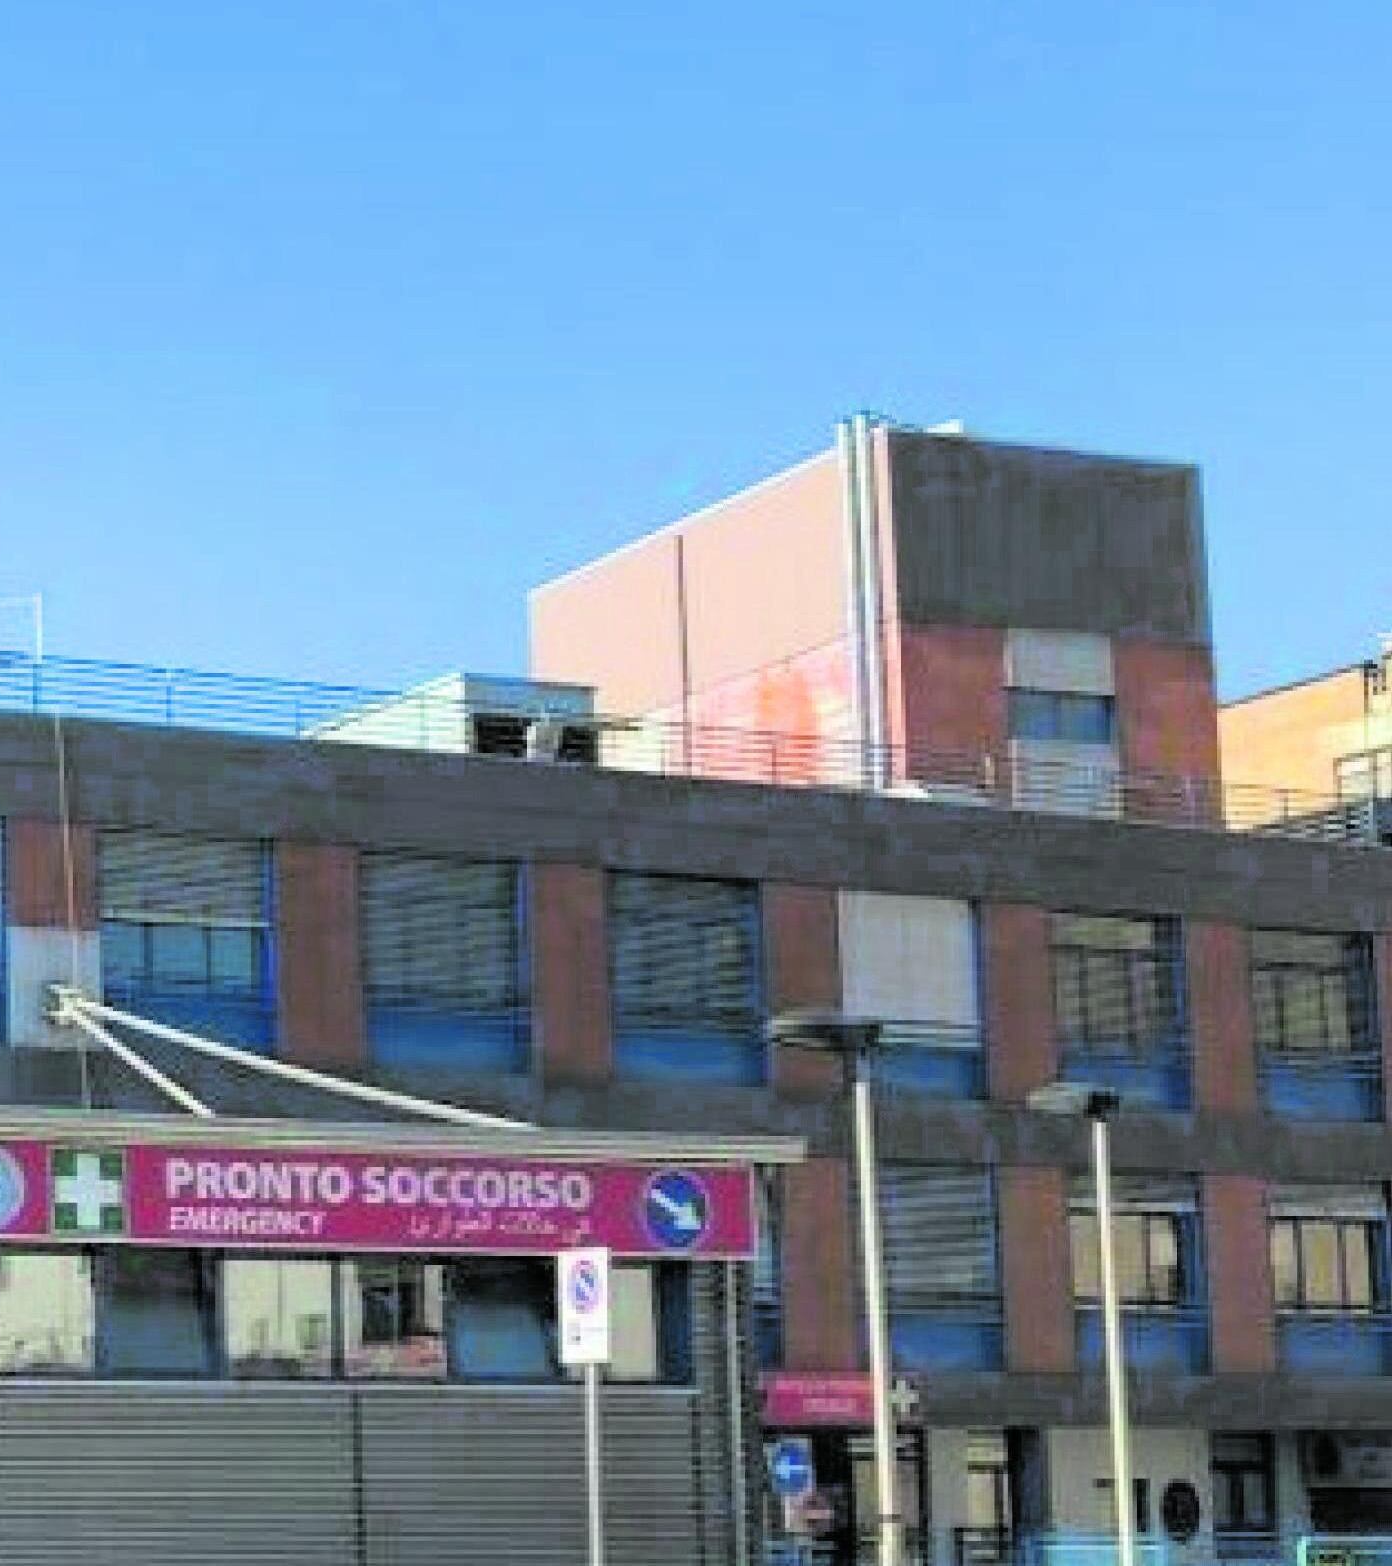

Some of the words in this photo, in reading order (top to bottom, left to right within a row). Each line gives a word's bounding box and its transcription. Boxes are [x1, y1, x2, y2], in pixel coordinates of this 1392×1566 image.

[166, 1158, 352, 1203] PRONTO
[361, 1166, 591, 1208] SOCCORSO
[170, 1206, 326, 1235] EMERGENCY
